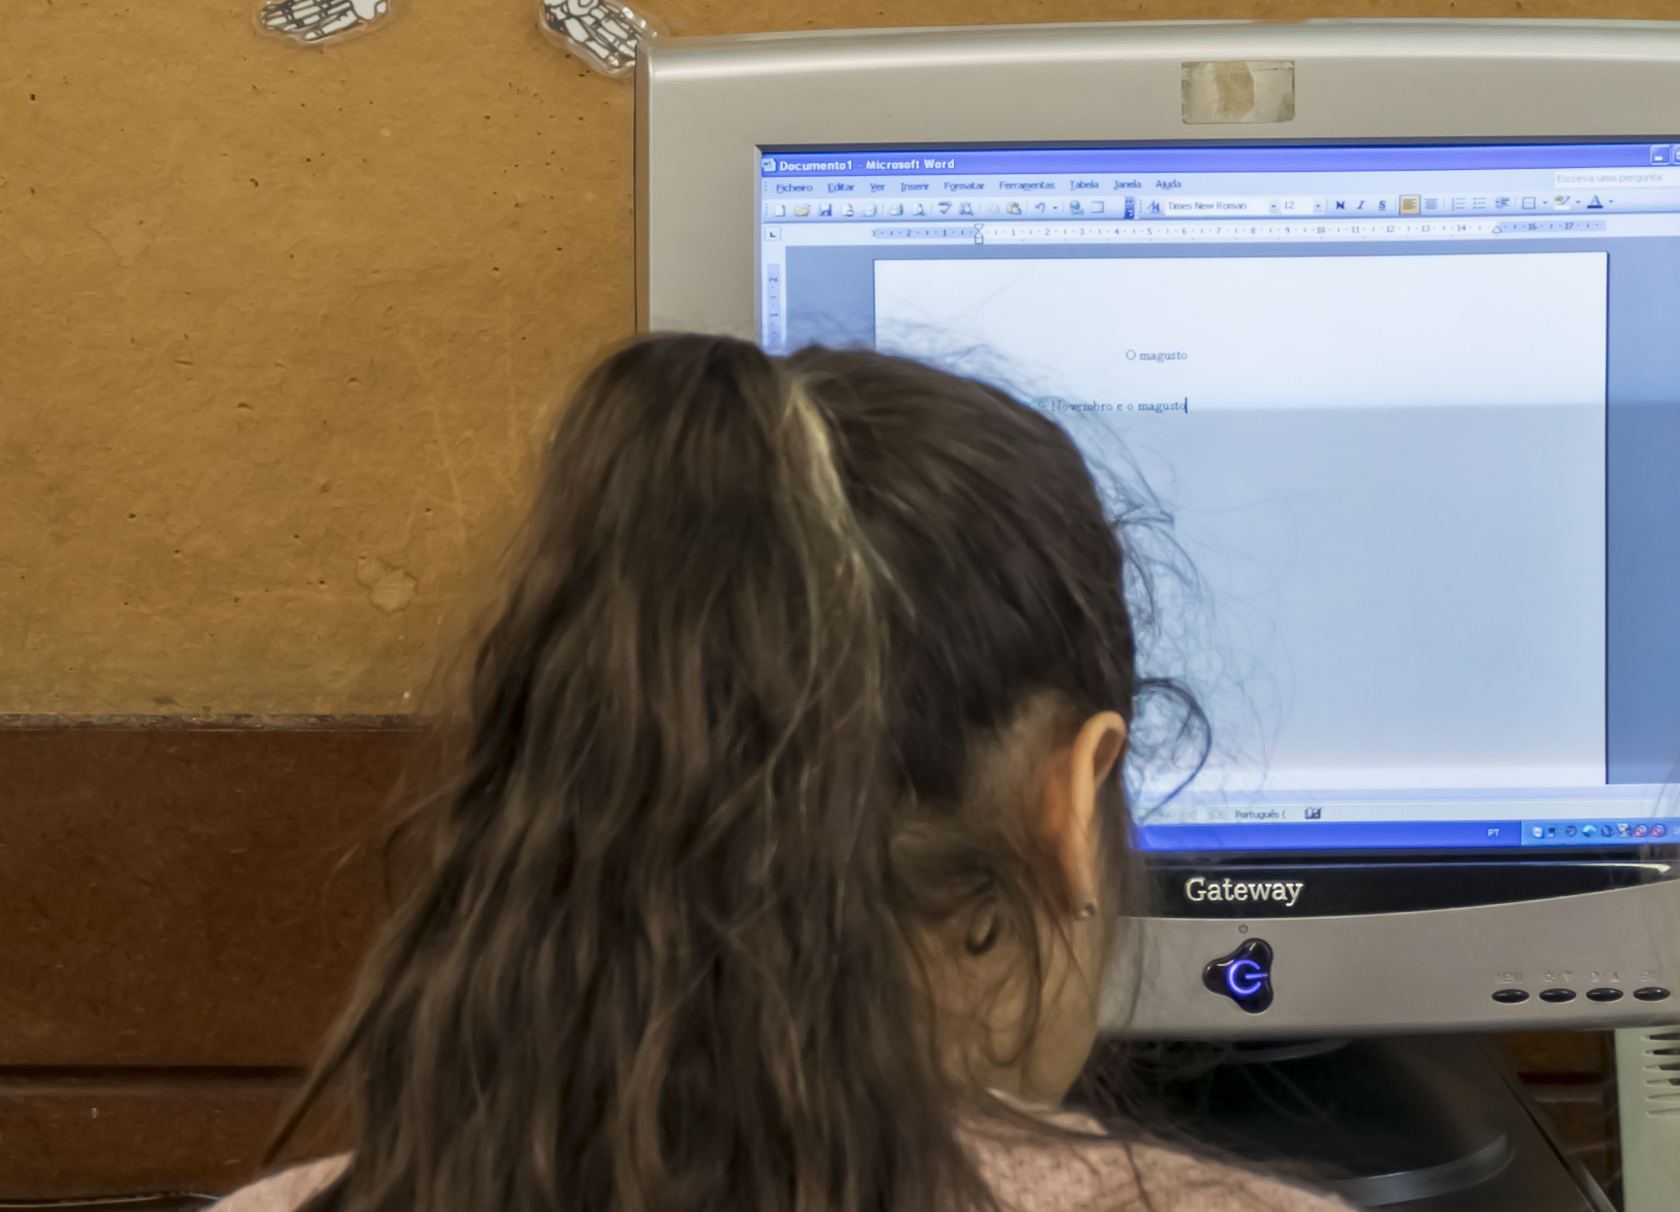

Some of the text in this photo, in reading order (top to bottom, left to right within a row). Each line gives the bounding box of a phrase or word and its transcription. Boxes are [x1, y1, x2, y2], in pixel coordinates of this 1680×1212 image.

[779, 159, 955, 172] Documento1 Microsoft Word
[776, 183, 813, 194] Ficheiro
[827, 183, 855, 193] Editar
[870, 183, 885, 192] Ver
[900, 182, 930, 193] Inserir
[944, 181, 985, 192] Formatar
[999, 180, 1055, 191] Ferramentas
[1070, 180, 1099, 191] Tabela
[1113, 180, 1142, 190] Janela
[1155, 179, 1182, 190] Ajuda
[1168, 201, 1247, 211] Times New Roman
[1283, 201, 1295, 210] 12
[1125, 348, 1188, 363] O magusto
[1051, 400, 1113, 412] Novembro
[1137, 401, 1186, 414] magusto
[1235, 809, 1280, 820] Português
[1186, 876, 1304, 907] Gateway
